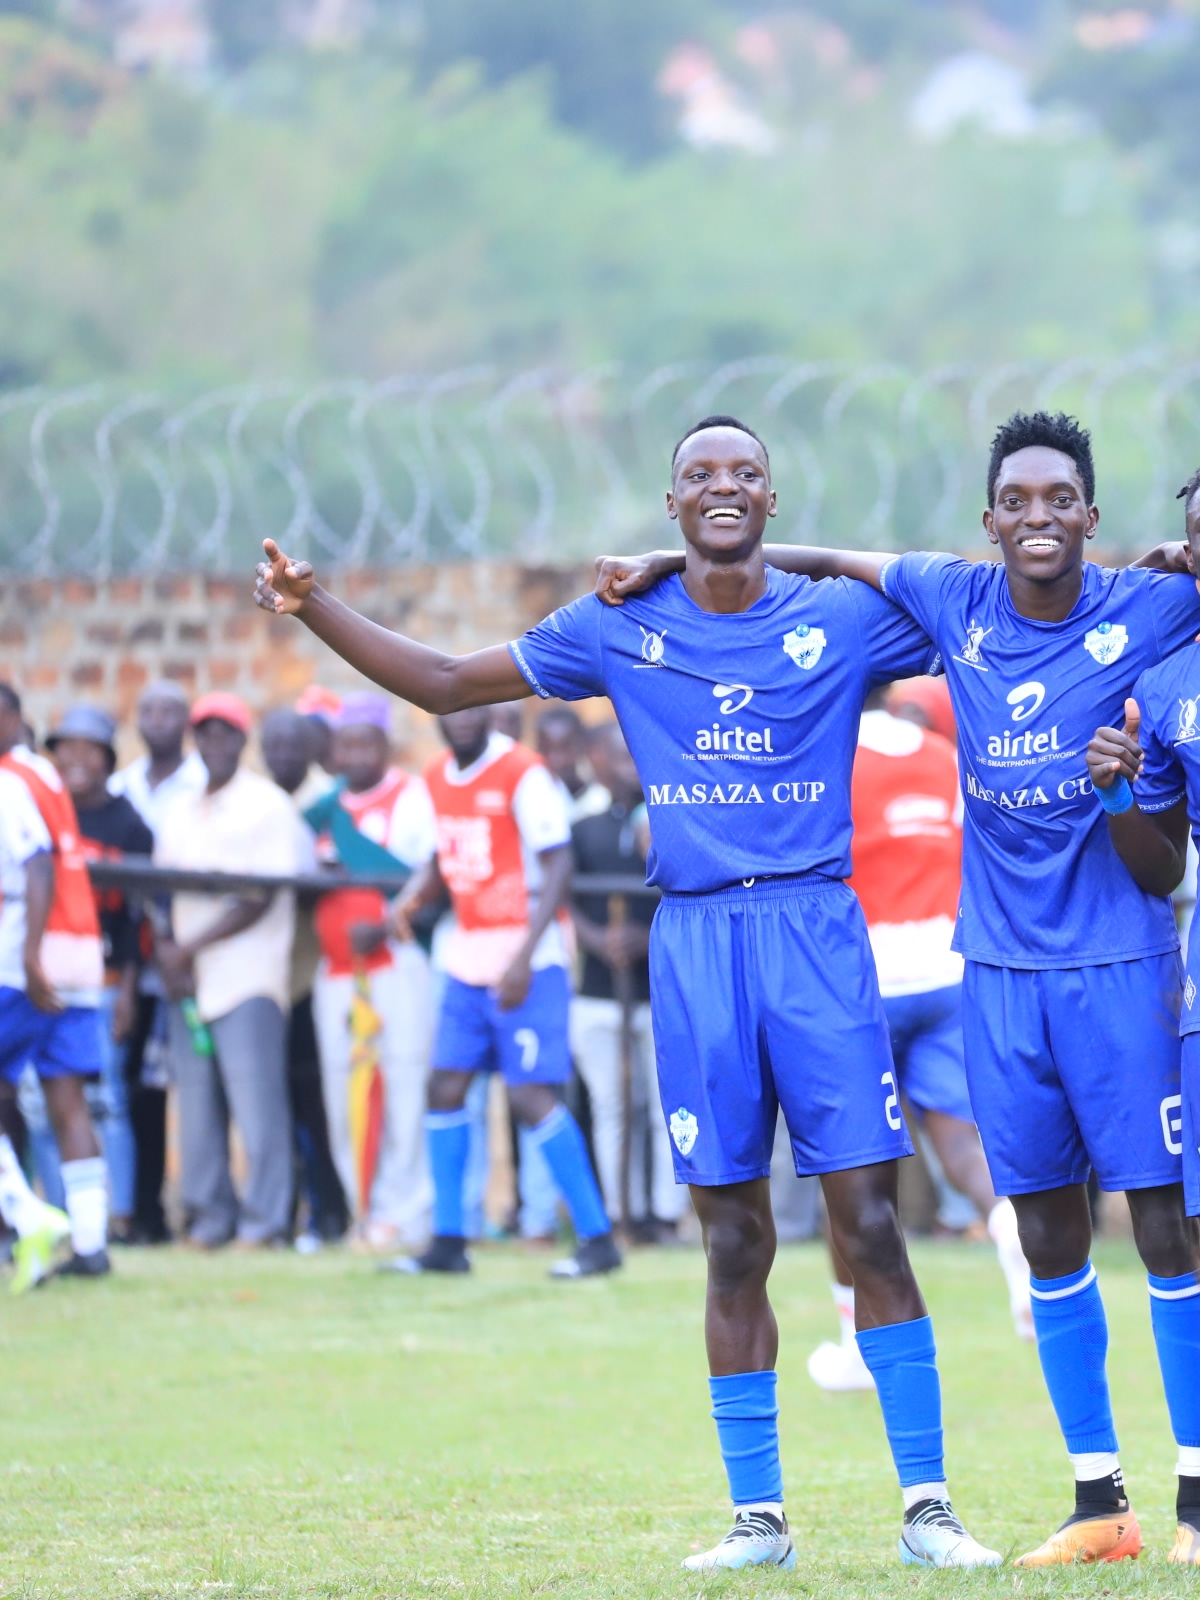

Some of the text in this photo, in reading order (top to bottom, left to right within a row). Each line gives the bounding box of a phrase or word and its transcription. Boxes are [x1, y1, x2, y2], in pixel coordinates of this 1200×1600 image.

[695, 722, 774, 753] airtel
[987, 725, 1060, 758] airtel
[681, 753, 697, 761] THE
[697, 753, 750, 761] SMARTPHONE
[976, 750, 1078, 768] THE SMARTPHONE NETWORK
[649, 781, 826, 805] MASAZA CUP
[1057, 776, 1095, 801] CU
